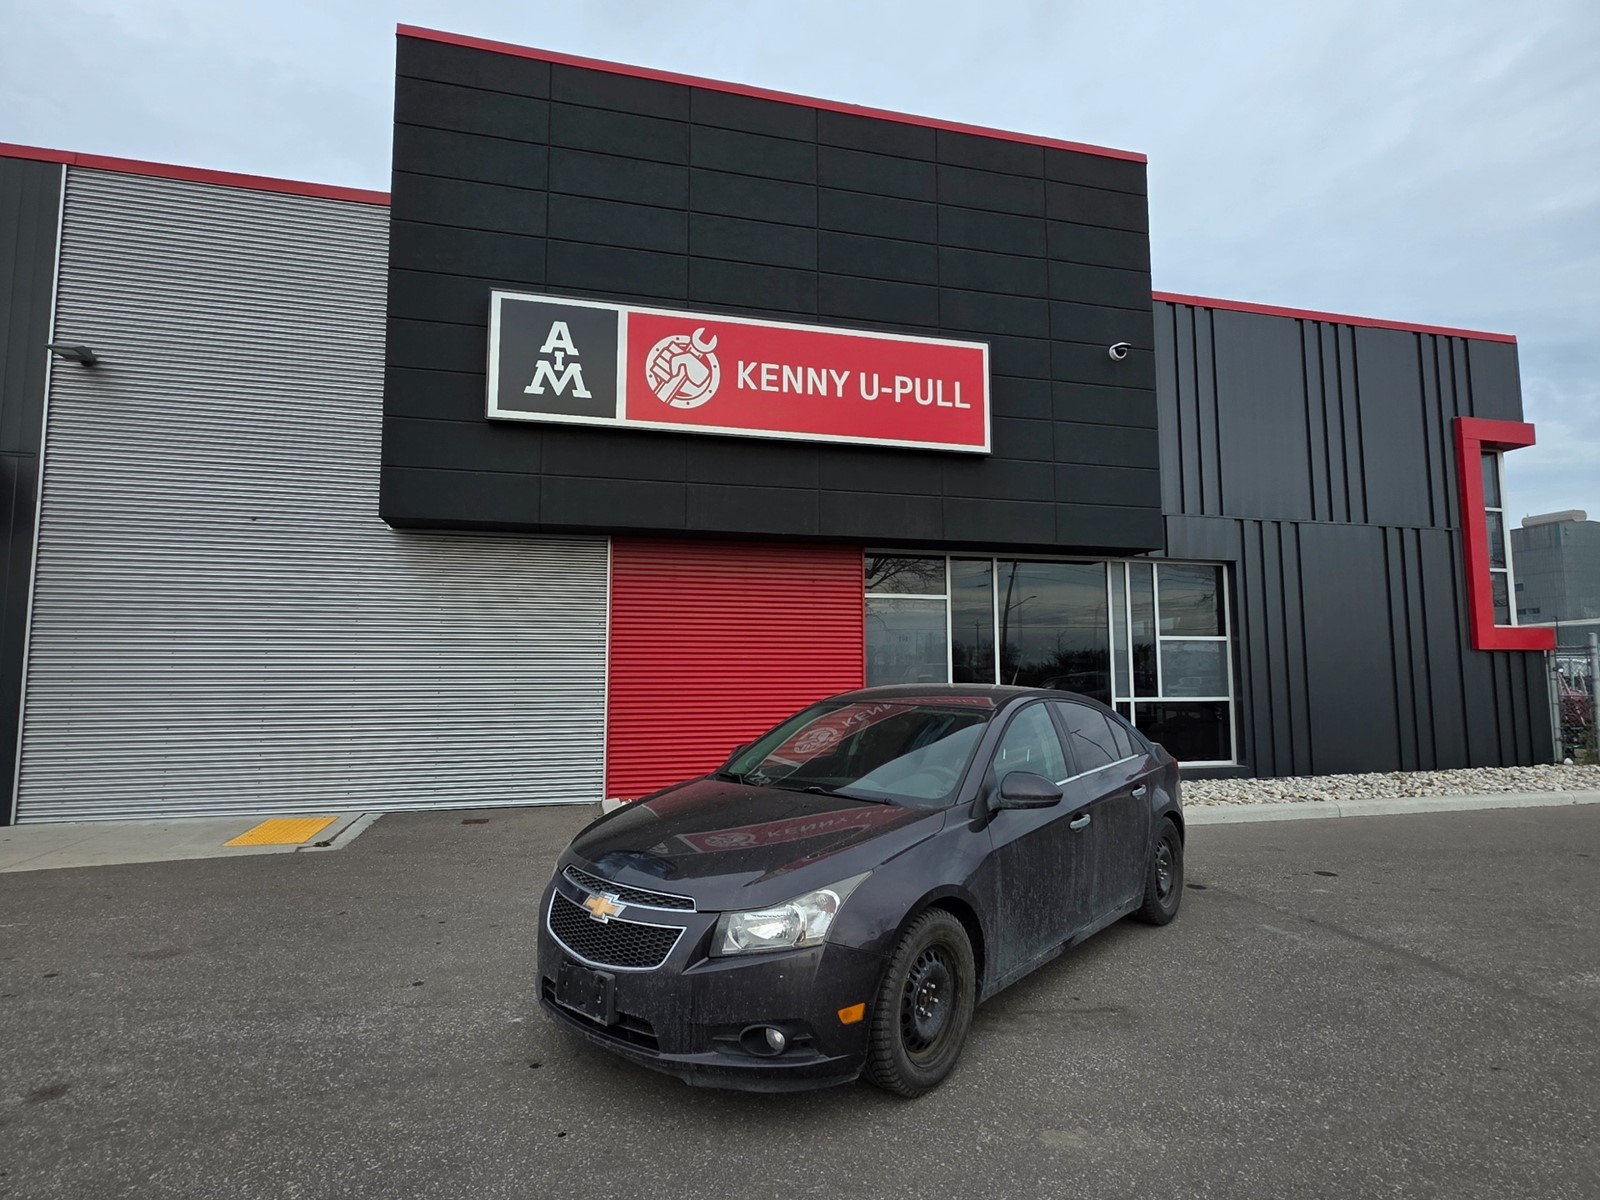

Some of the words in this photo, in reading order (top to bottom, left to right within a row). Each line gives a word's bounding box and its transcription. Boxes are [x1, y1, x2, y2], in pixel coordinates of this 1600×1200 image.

[524, 321, 592, 398] AIM
[737, 360, 850, 397] KENNY
[860, 372, 971, 409] U-PULL
